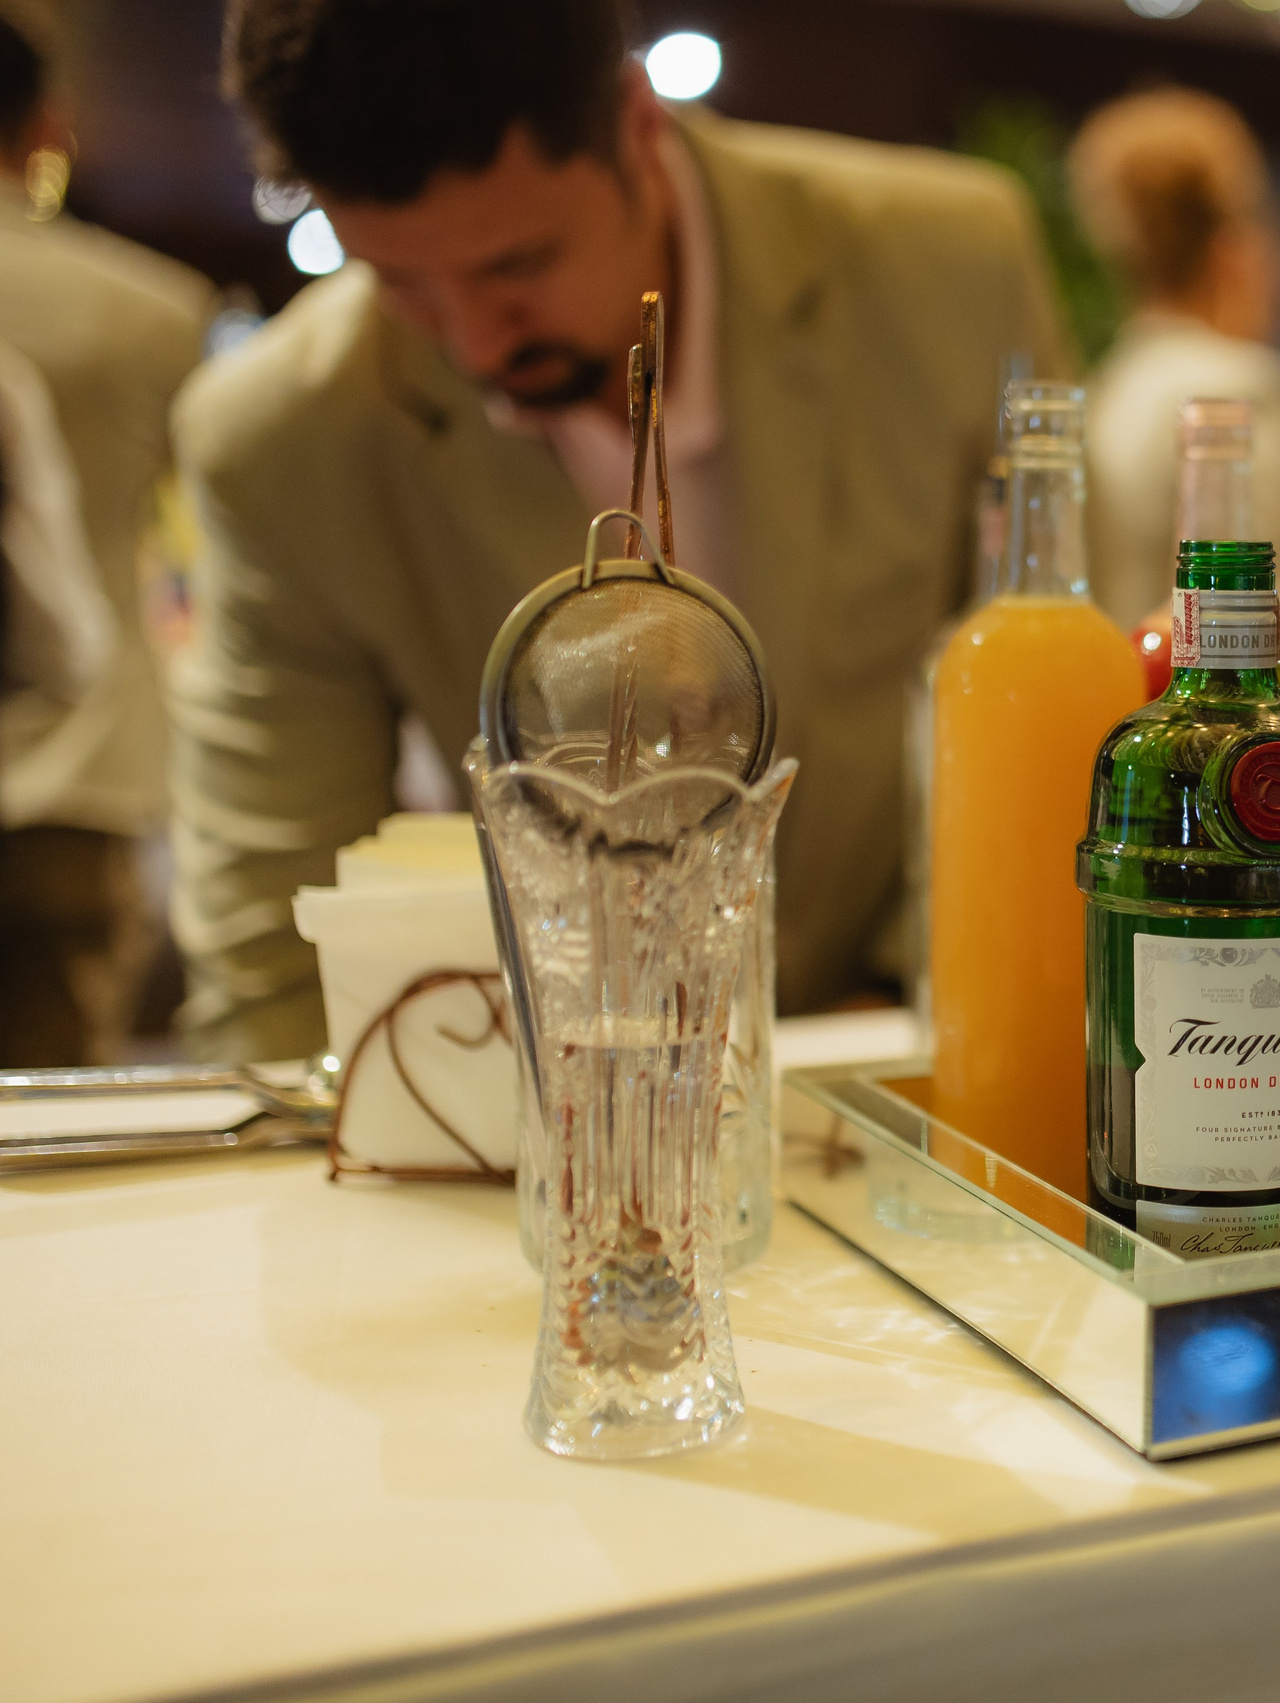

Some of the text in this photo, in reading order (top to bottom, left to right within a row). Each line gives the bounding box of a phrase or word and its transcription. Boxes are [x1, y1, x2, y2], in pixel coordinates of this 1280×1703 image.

[1199, 634, 1259, 649] LONDON
[1194, 1077, 1259, 1089] LONDON
[1224, 1125, 1273, 1133] SIGNATURE
